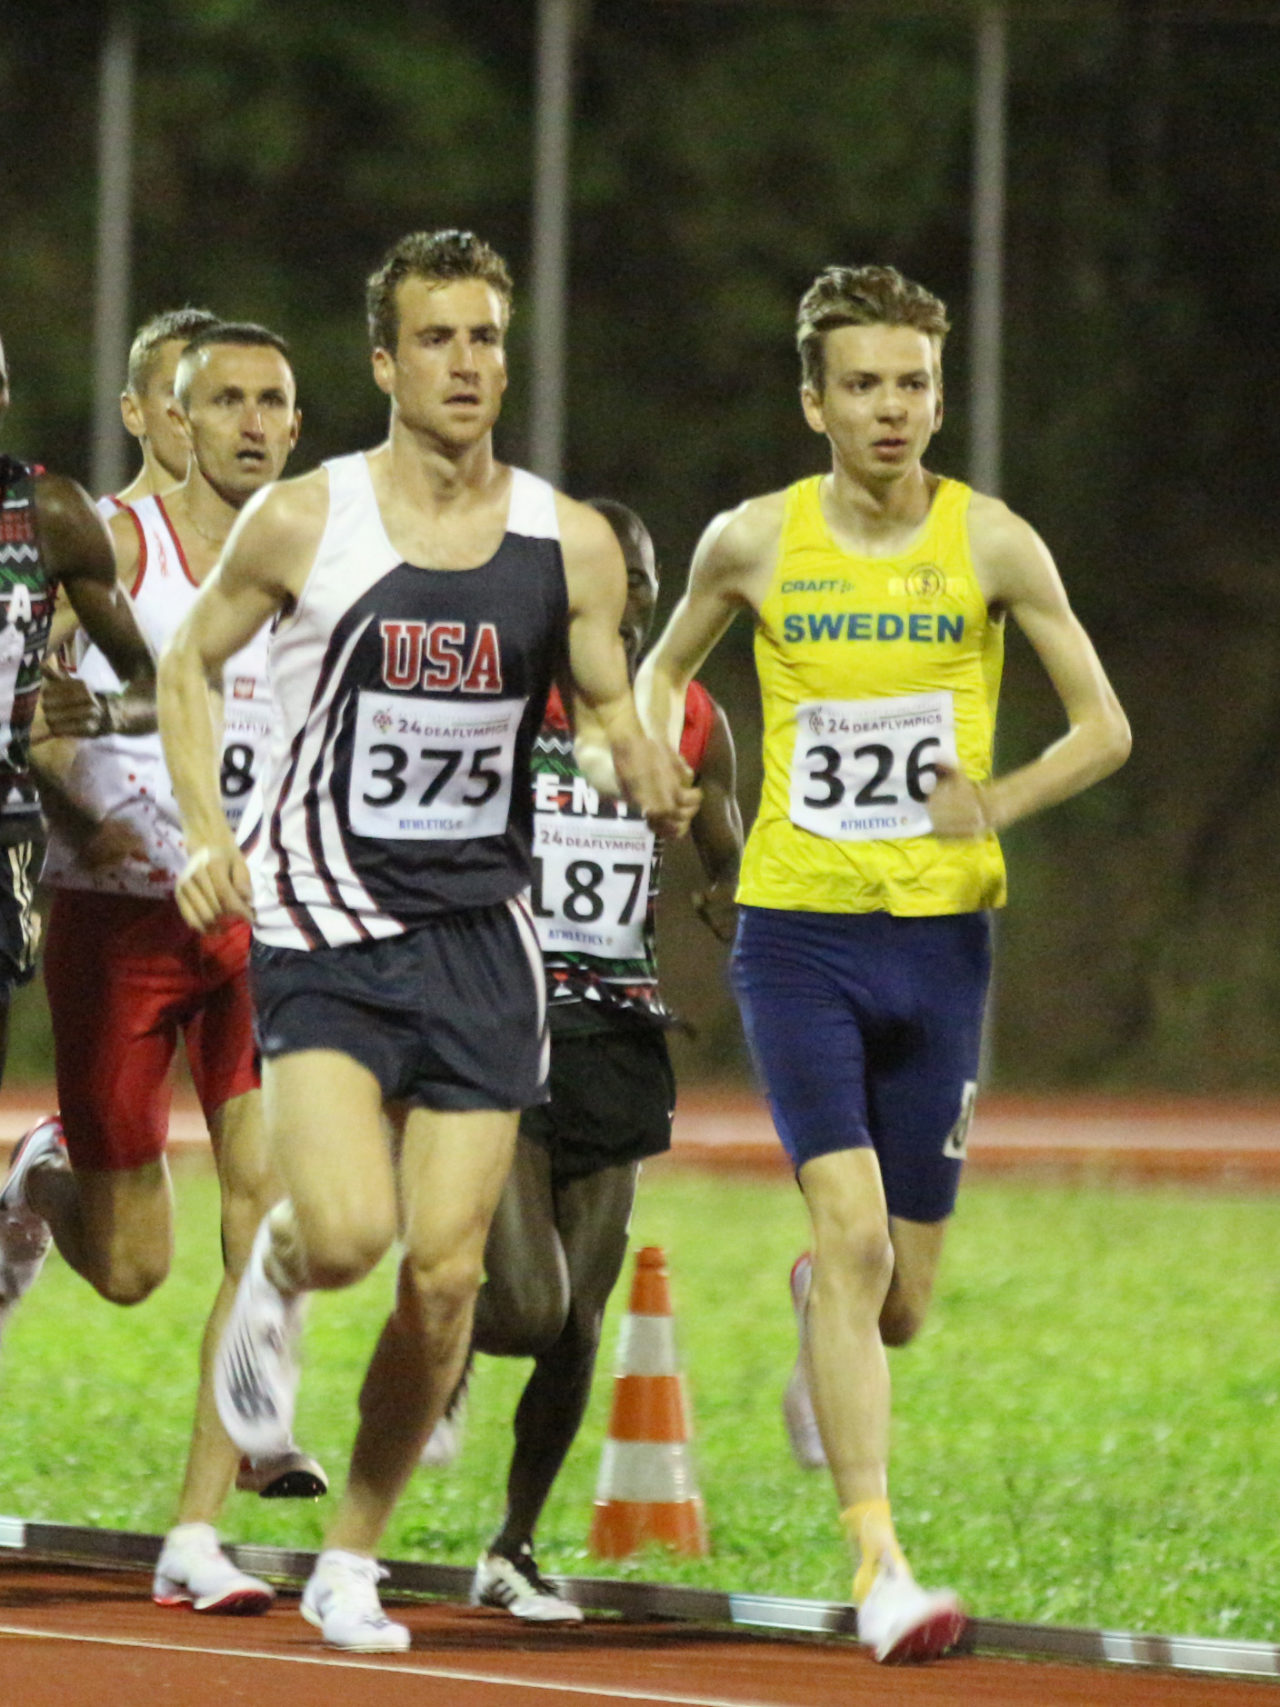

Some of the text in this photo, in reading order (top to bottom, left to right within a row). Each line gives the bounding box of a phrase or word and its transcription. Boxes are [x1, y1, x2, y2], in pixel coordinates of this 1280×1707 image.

[781, 579, 838, 594] CRAFT
[783, 613, 965, 644] SWEDEN
[380, 620, 502, 693] USA
[398, 718, 509, 739] 24 DEAFLYMPICS
[828, 713, 943, 734] 24 DEAFLYMPICS
[363, 744, 502, 807] 375
[803, 737, 942, 809] 326
[399, 819, 454, 831] ATHLETICS
[840, 817, 898, 830] ATHLETICS
[541, 831, 647, 851] 24 DEAFLYMPICS
[530, 856, 644, 926] 187
[548, 929, 604, 945] ATHLETICS
